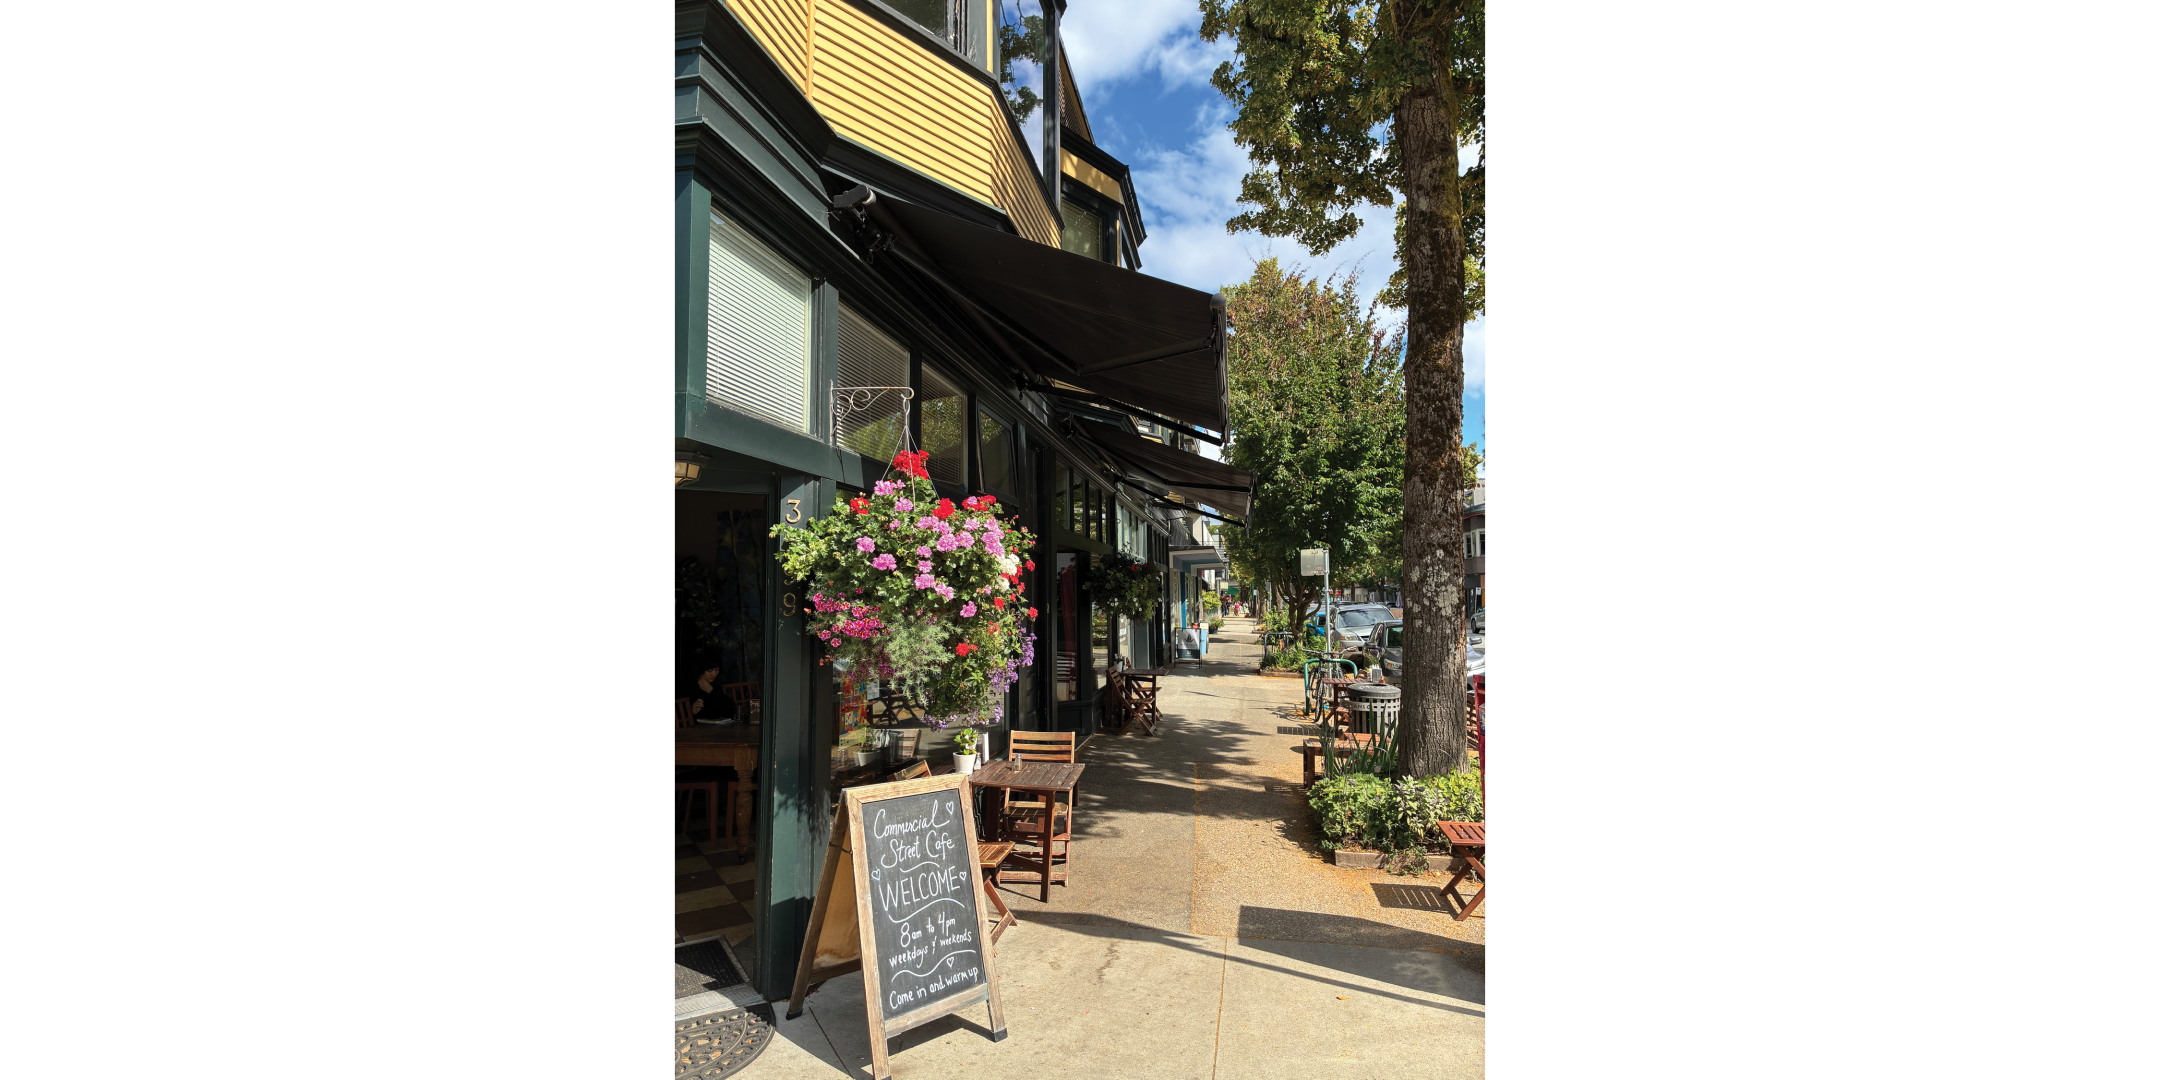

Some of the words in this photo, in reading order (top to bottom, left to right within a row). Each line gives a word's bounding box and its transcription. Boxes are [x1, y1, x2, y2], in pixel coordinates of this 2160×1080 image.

[874, 799, 950, 839] Commercial
[880, 835, 921, 869] Street
[925, 829, 955, 860] Cafe
[878, 865, 961, 912] WELCOME
[926, 917, 935, 933] to
[937, 911, 956, 937] 4pm
[888, 945, 929, 968] weekdays
[939, 928, 972, 946] weekends
[889, 990, 914, 1010] Come
[915, 985, 927, 998] in
[929, 974, 946, 993] and
[945, 970, 968, 986] warm
[968, 966, 979, 983] up
